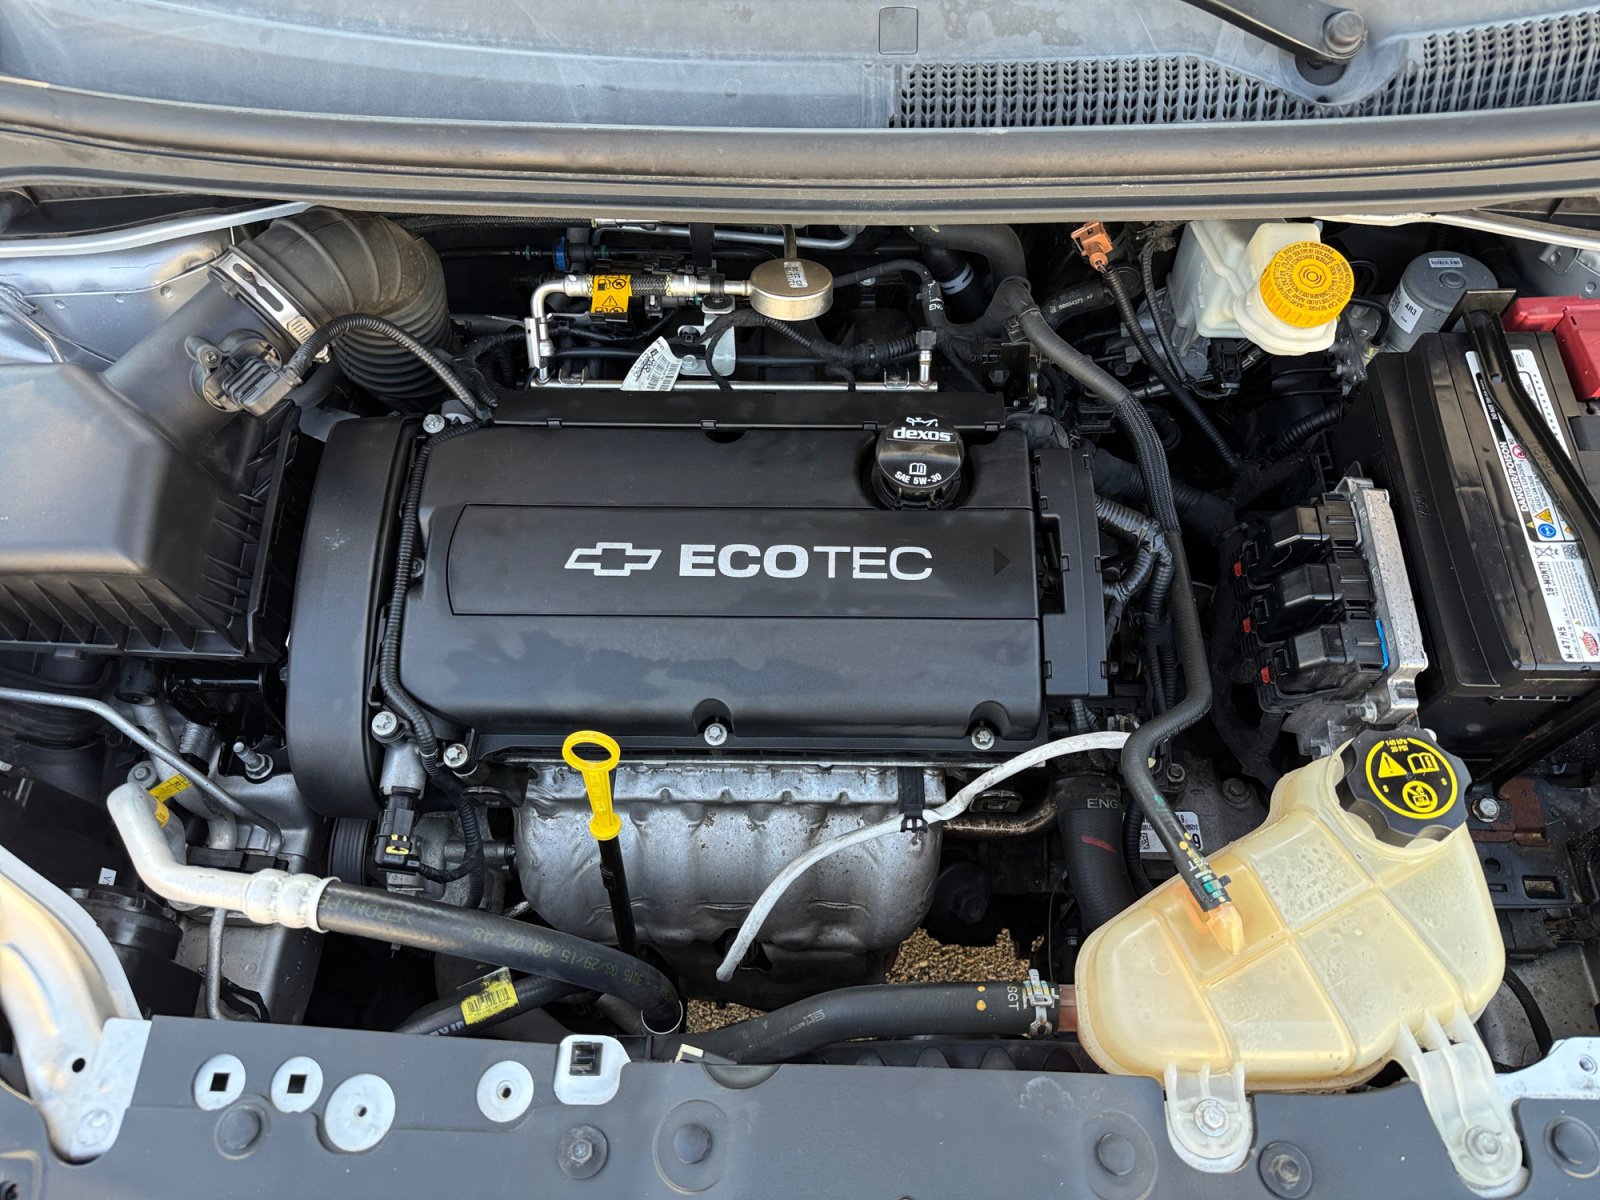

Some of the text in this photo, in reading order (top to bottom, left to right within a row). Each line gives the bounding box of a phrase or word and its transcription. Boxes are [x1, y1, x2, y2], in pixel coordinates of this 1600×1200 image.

[1403, 302, 1418, 316] AR3
[893, 427, 953, 441] dexos
[895, 471, 942, 485] SAE 5W-30
[1499, 440, 1529, 513] DANGER/POISON
[679, 543, 933, 580] ECOTEC
[1537, 562, 1555, 596] 18-MONTH
[1087, 798, 1118, 809] ENG
[1007, 985, 1019, 1011] SGT
